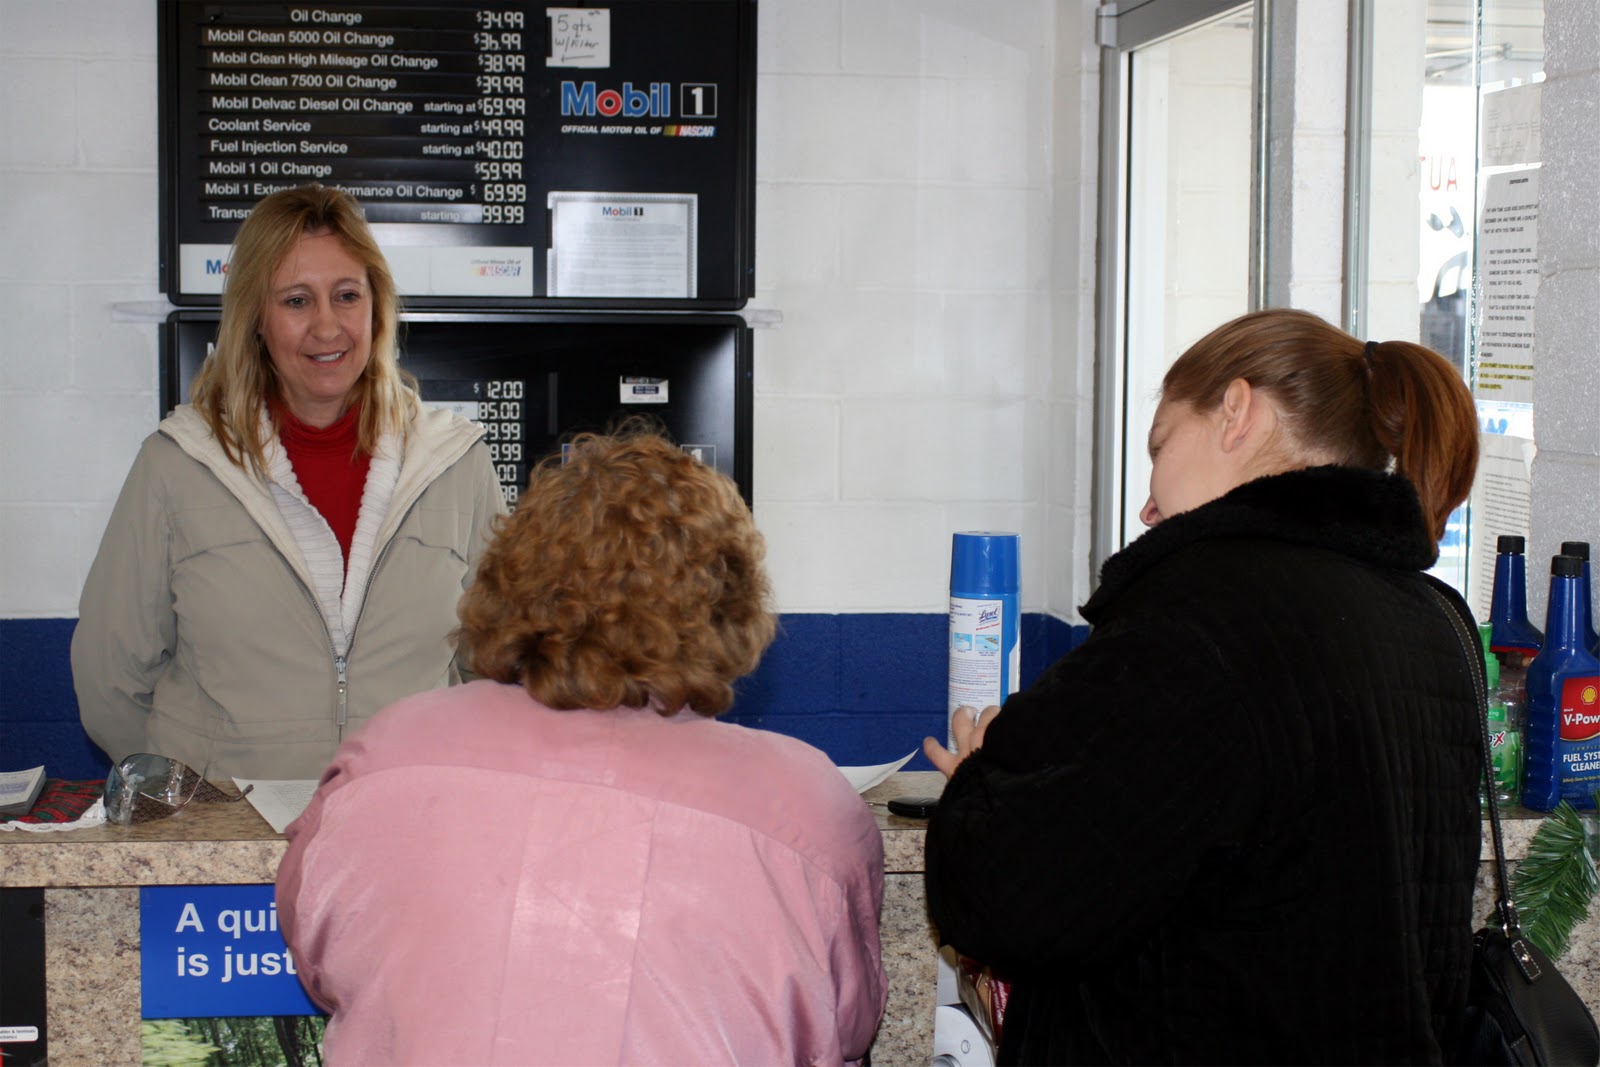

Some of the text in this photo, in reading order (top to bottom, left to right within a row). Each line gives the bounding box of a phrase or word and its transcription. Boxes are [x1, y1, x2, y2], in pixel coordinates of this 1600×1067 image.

[291, 9, 524, 29] Oil Change $34.99
[558, 14, 569, 32] 5
[208, 29, 244, 41] Mobil
[248, 30, 285, 42] Clean
[289, 31, 320, 43] 5000
[323, 31, 340, 43] Oil
[344, 32, 394, 47] Change
[213, 52, 525, 72] Mobil Clean High Mileage Oil Change $38.99
[211, 73, 523, 94] Mobil Clean 7500 Oil Change $39.99
[212, 97, 248, 109] Mobil
[252, 97, 296, 110] Delvac
[300, 98, 339, 110] Diesel
[342, 98, 359, 111] Oil
[363, 99, 413, 114] Change
[424, 102, 463, 114] starting
[466, 103, 476, 112] at
[561, 81, 671, 117] Mobil
[209, 118, 259, 131] Coolant
[263, 119, 311, 131] Service
[421, 123, 460, 135] starting
[463, 124, 472, 133] at
[561, 125, 714, 136] OFFICIAL MOTOR OIL OF NASCAR
[211, 140, 523, 159] Fuel Injection Service starting at $40.00
[210, 162, 245, 174] Mobil
[250, 163, 255, 174] 1
[261, 162, 278, 174] Oil
[281, 162, 332, 177] Change
[205, 183, 239, 194] Mobil
[243, 184, 249, 194] 1
[397, 185, 414, 197] Oil
[416, 186, 463, 200] Change
[484, 185, 525, 202] 69.99
[421, 210, 460, 222] starting
[483, 206, 524, 224] 99.99
[602, 207, 632, 216] Mobil
[488, 381, 522, 398] 12.00
[479, 402, 520, 419] 85.00
[1563, 754, 1581, 762] FUEL
[176, 903, 204, 932] A
[178, 946, 297, 982] is just
